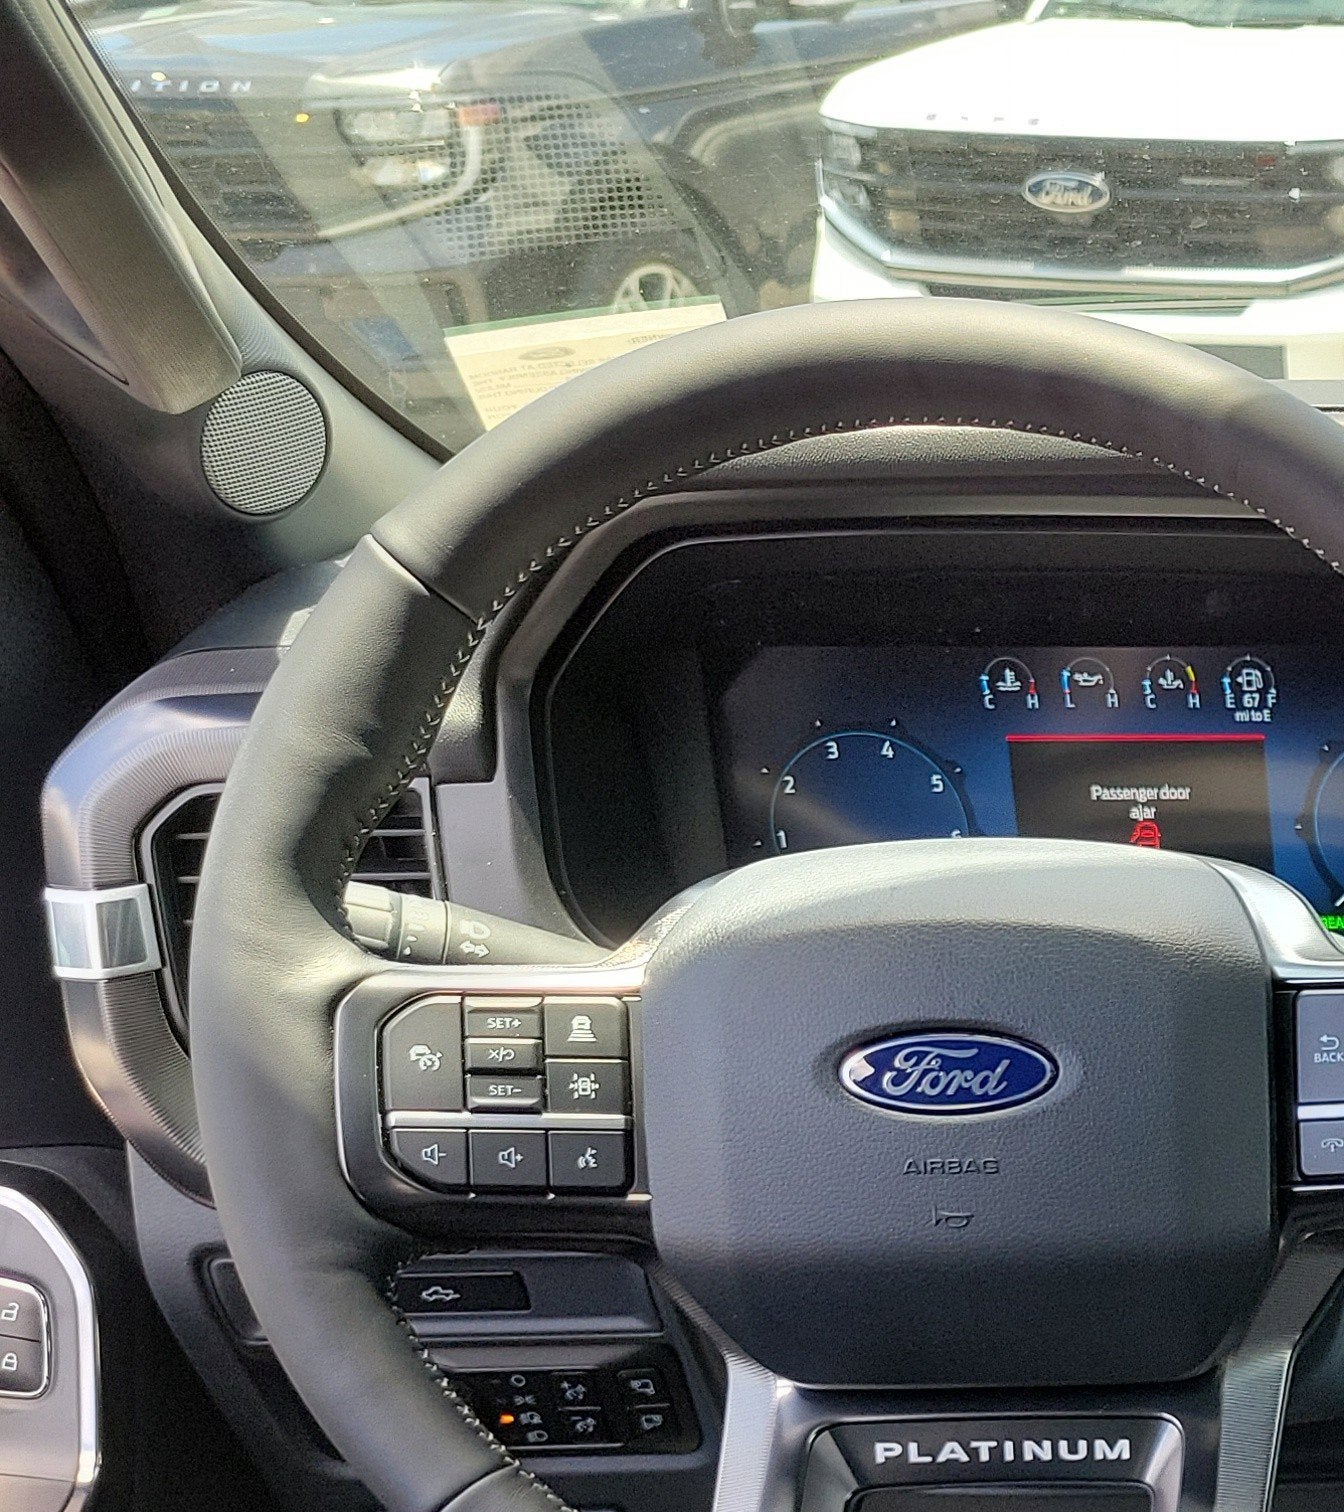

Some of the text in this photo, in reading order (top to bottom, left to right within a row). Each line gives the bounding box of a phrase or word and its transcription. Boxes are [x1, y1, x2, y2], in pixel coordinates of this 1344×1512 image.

[983, 694, 995, 710] C
[1026, 694, 1040, 710] H
[1064, 694, 1075, 708] L
[1106, 693, 1120, 708] H
[1145, 694, 1157, 709] C
[1188, 694, 1201, 709] H
[1225, 694, 1236, 709] E
[1242, 694, 1260, 708] 67
[1267, 693, 1277, 708] F
[824, 741, 840, 760] 3
[879, 740, 895, 760] 4
[782, 775, 796, 794] 2
[930, 774, 945, 793] 5
[1090, 783, 1191, 802] Passenger door
[1129, 804, 1157, 821] ajar
[776, 830, 788, 849] 1
[882, 1045, 1011, 1097] Ford
[902, 1157, 1001, 1176] AIRBAG
[874, 1438, 1131, 1466] PLATINUM
